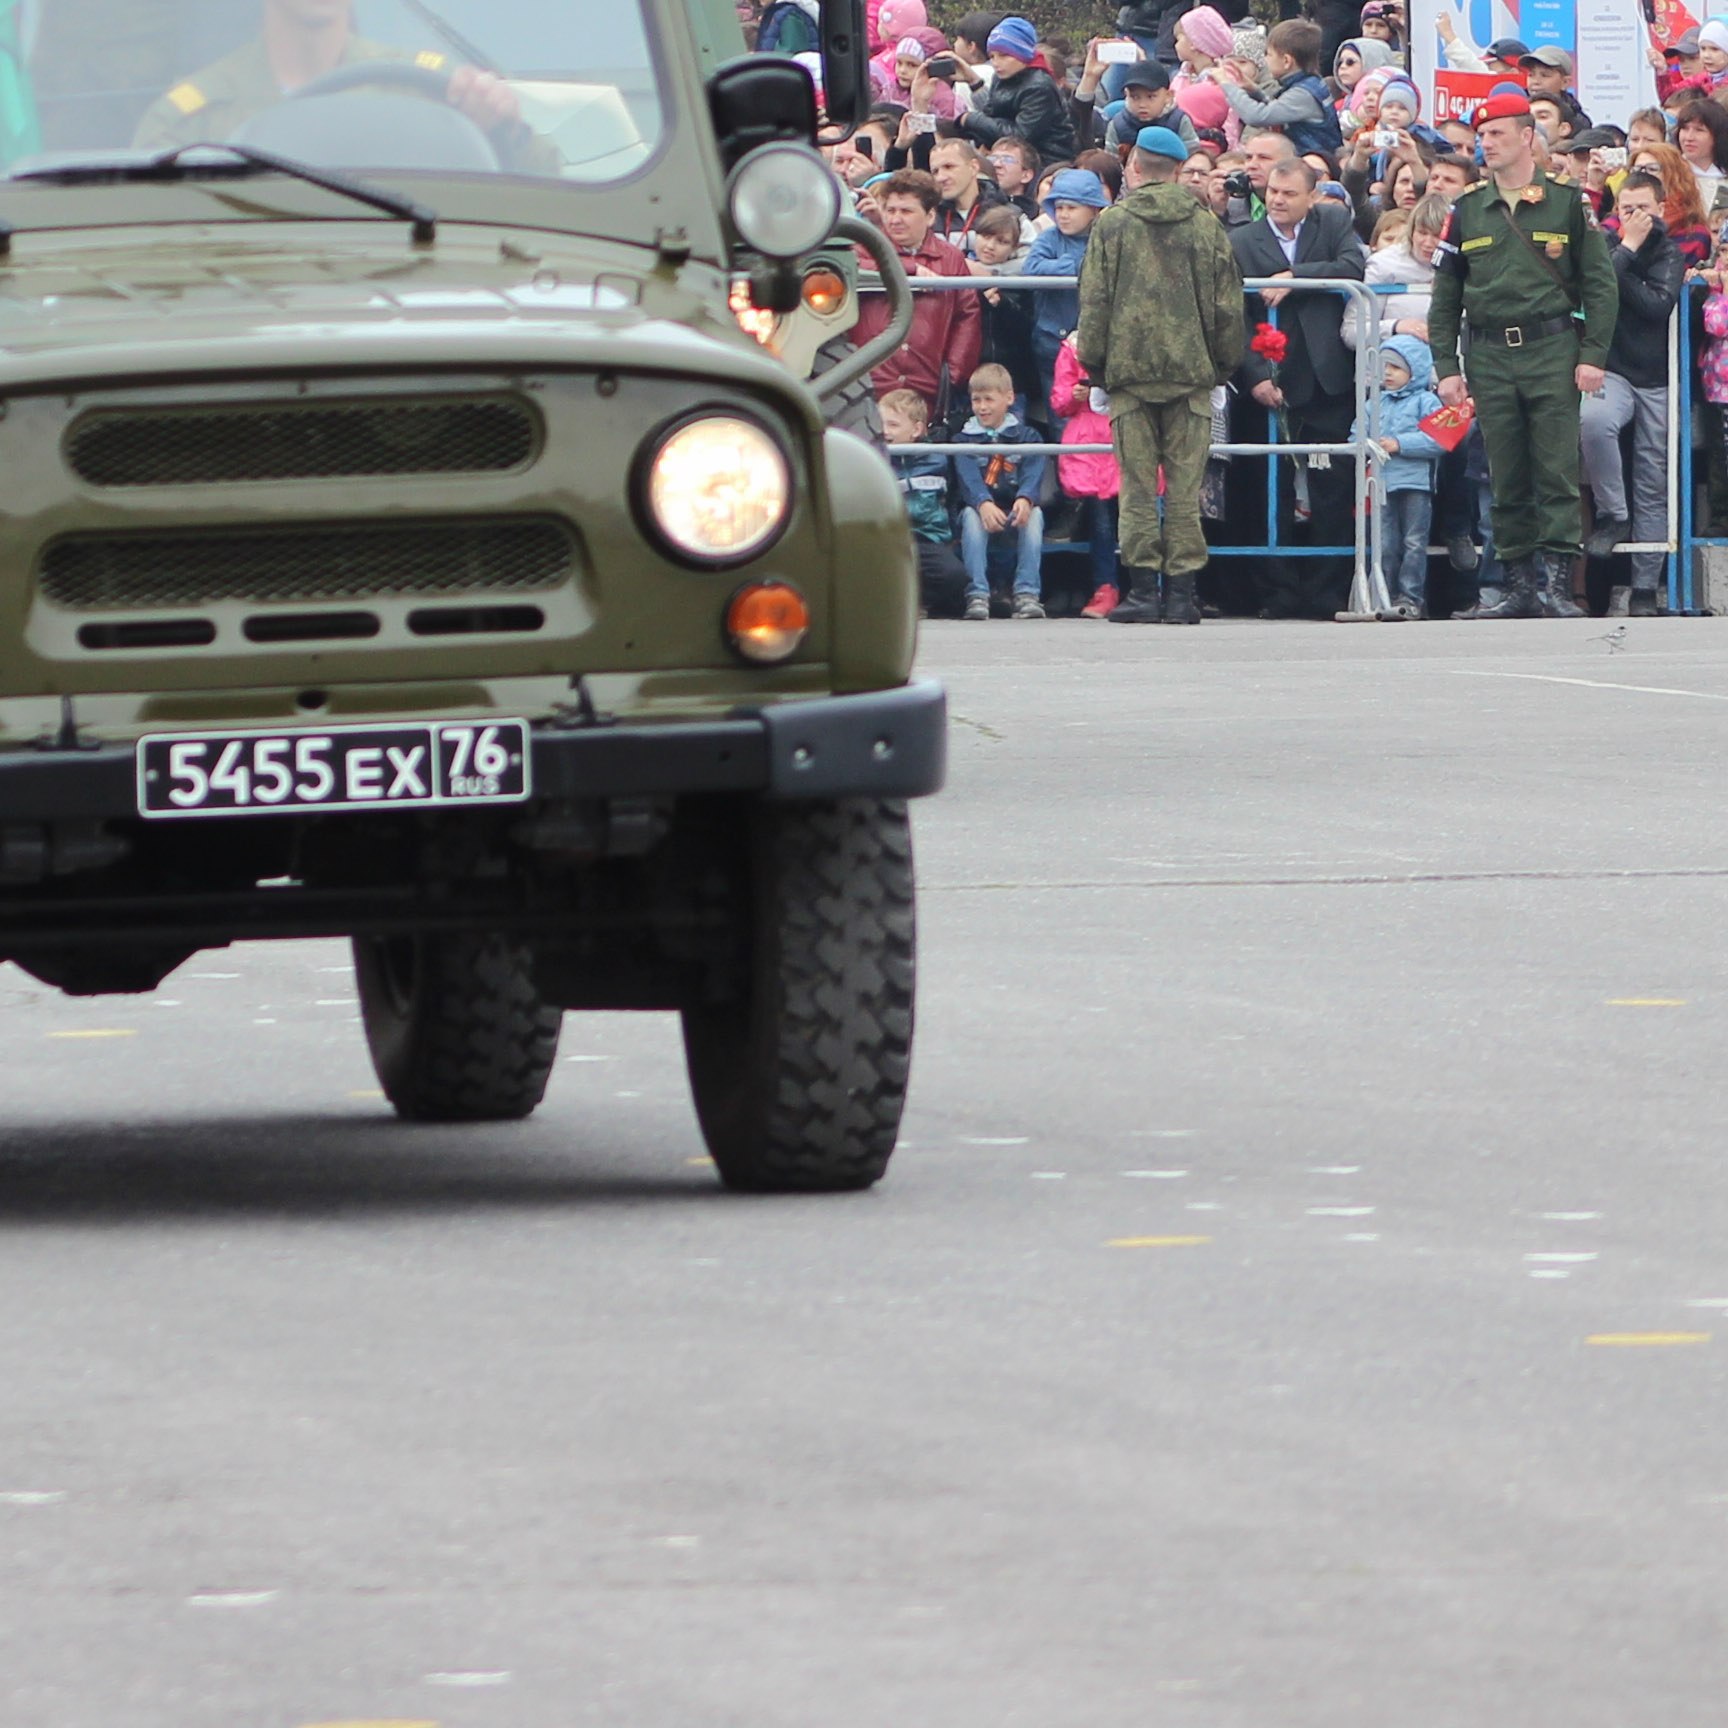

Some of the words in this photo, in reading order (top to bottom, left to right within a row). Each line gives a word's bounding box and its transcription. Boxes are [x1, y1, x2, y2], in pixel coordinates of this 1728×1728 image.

[167, 737, 335, 807] 5455
[439, 725, 507, 778] 76
[450, 775, 499, 796] RUS
